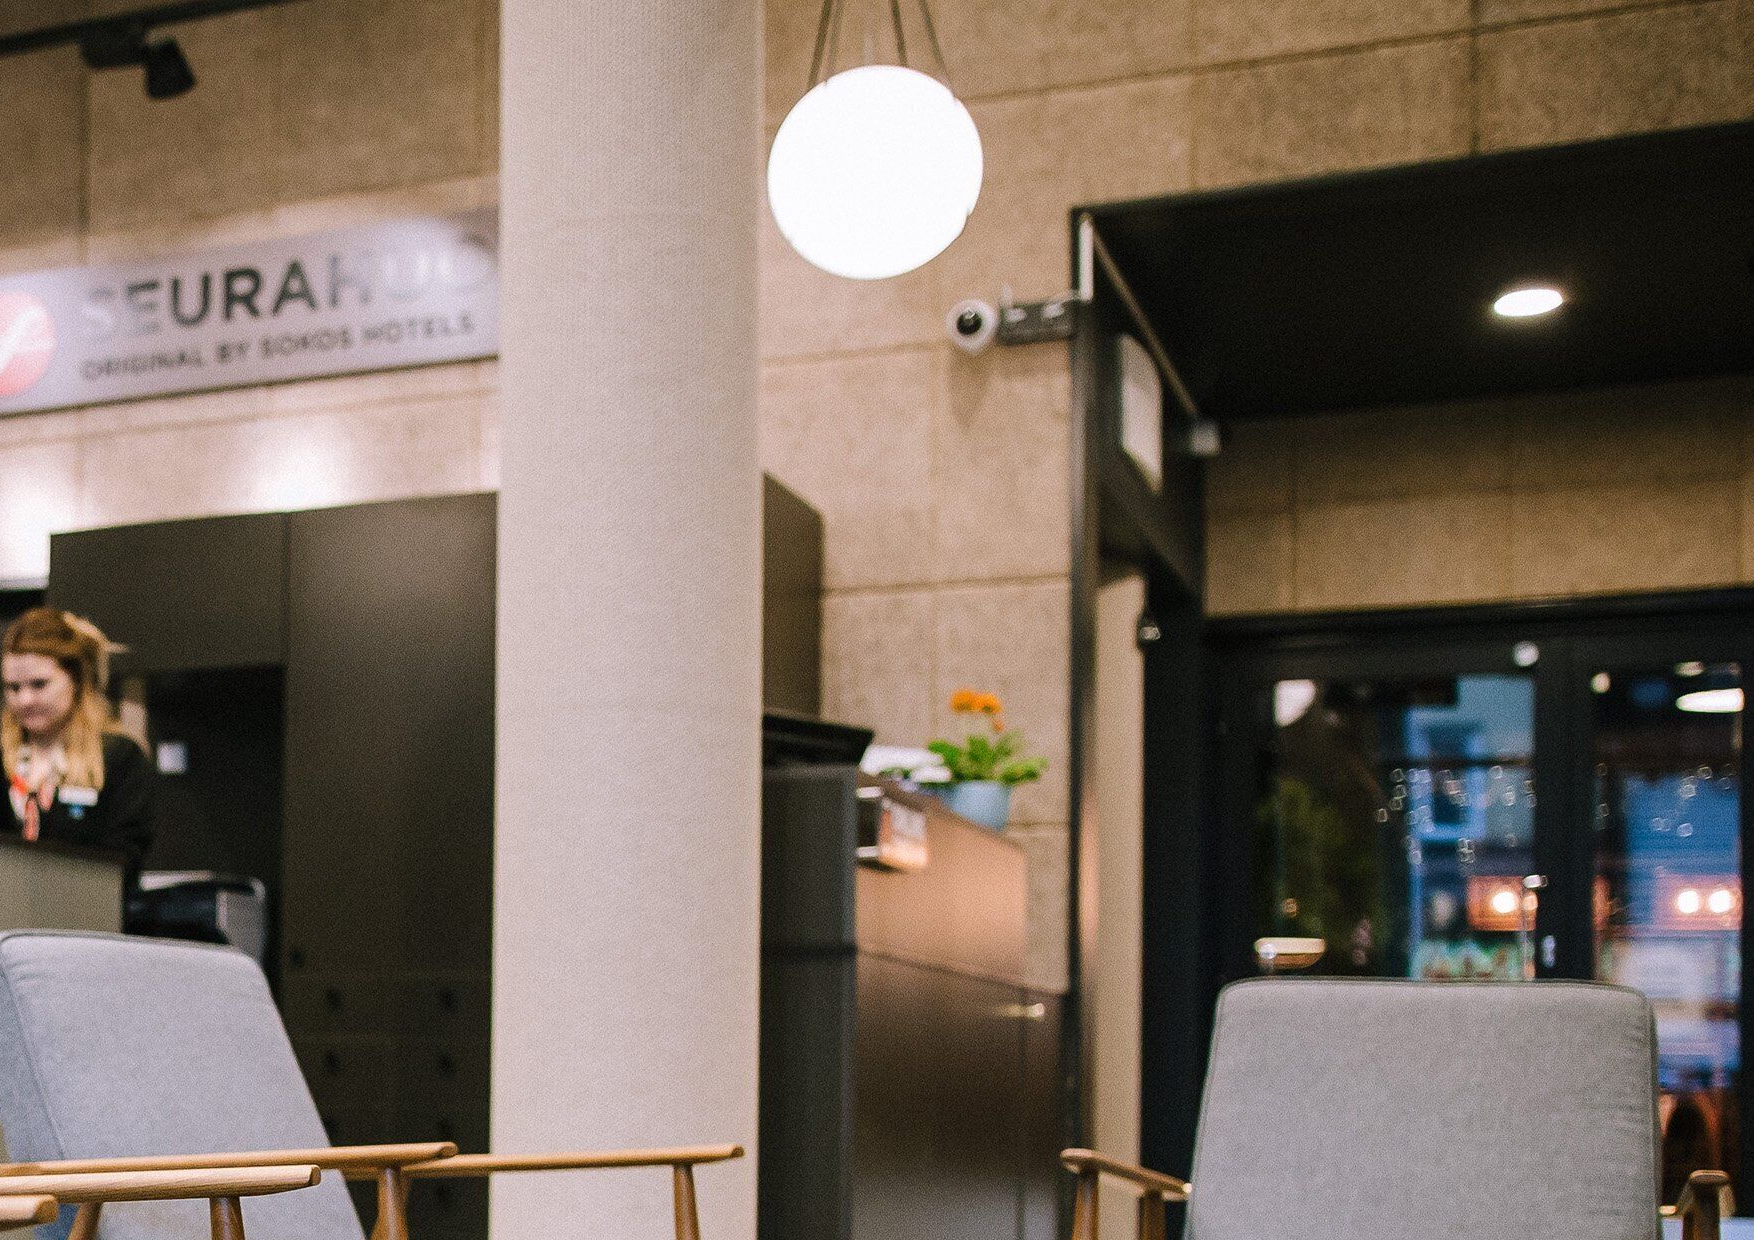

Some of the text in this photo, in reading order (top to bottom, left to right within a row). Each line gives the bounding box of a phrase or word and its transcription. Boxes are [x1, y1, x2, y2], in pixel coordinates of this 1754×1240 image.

[83, 313, 475, 380] ORIGINAL BY SOKOS HOTELS
